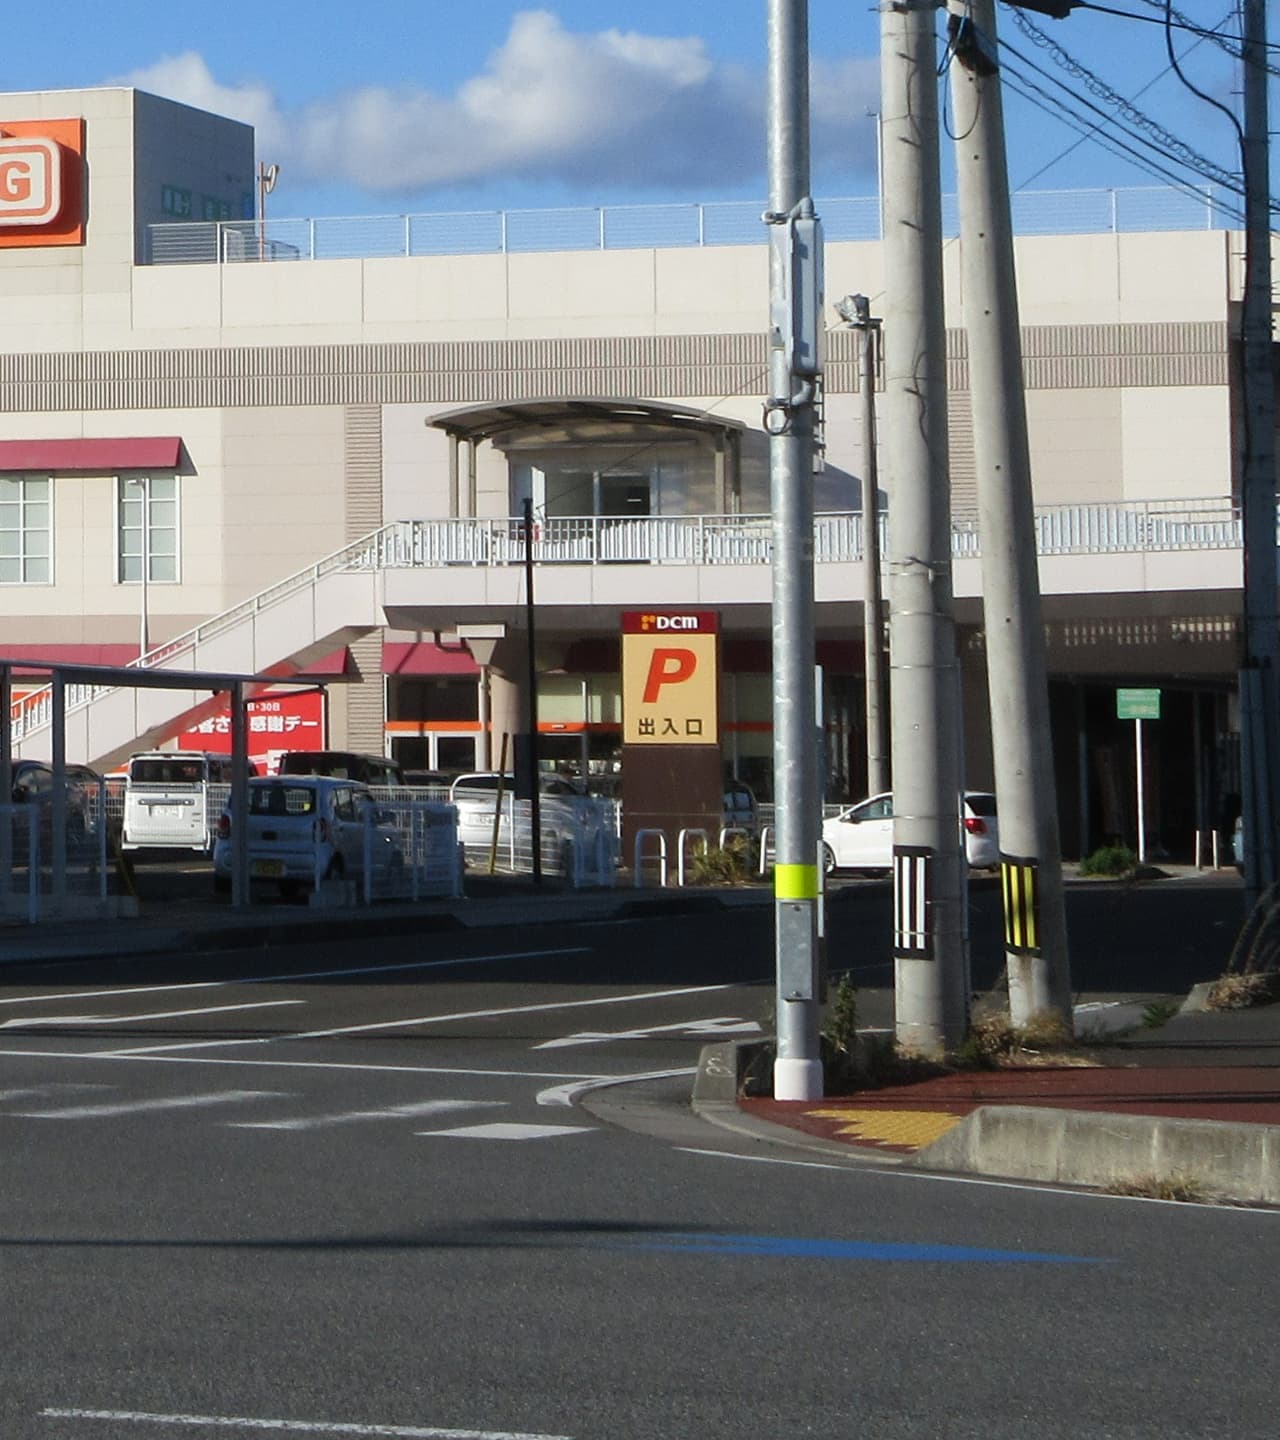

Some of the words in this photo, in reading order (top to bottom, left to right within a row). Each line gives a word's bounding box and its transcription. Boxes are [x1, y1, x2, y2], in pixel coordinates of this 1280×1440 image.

[642, 648, 697, 703] P
[638, 717, 703, 736] 出入口
